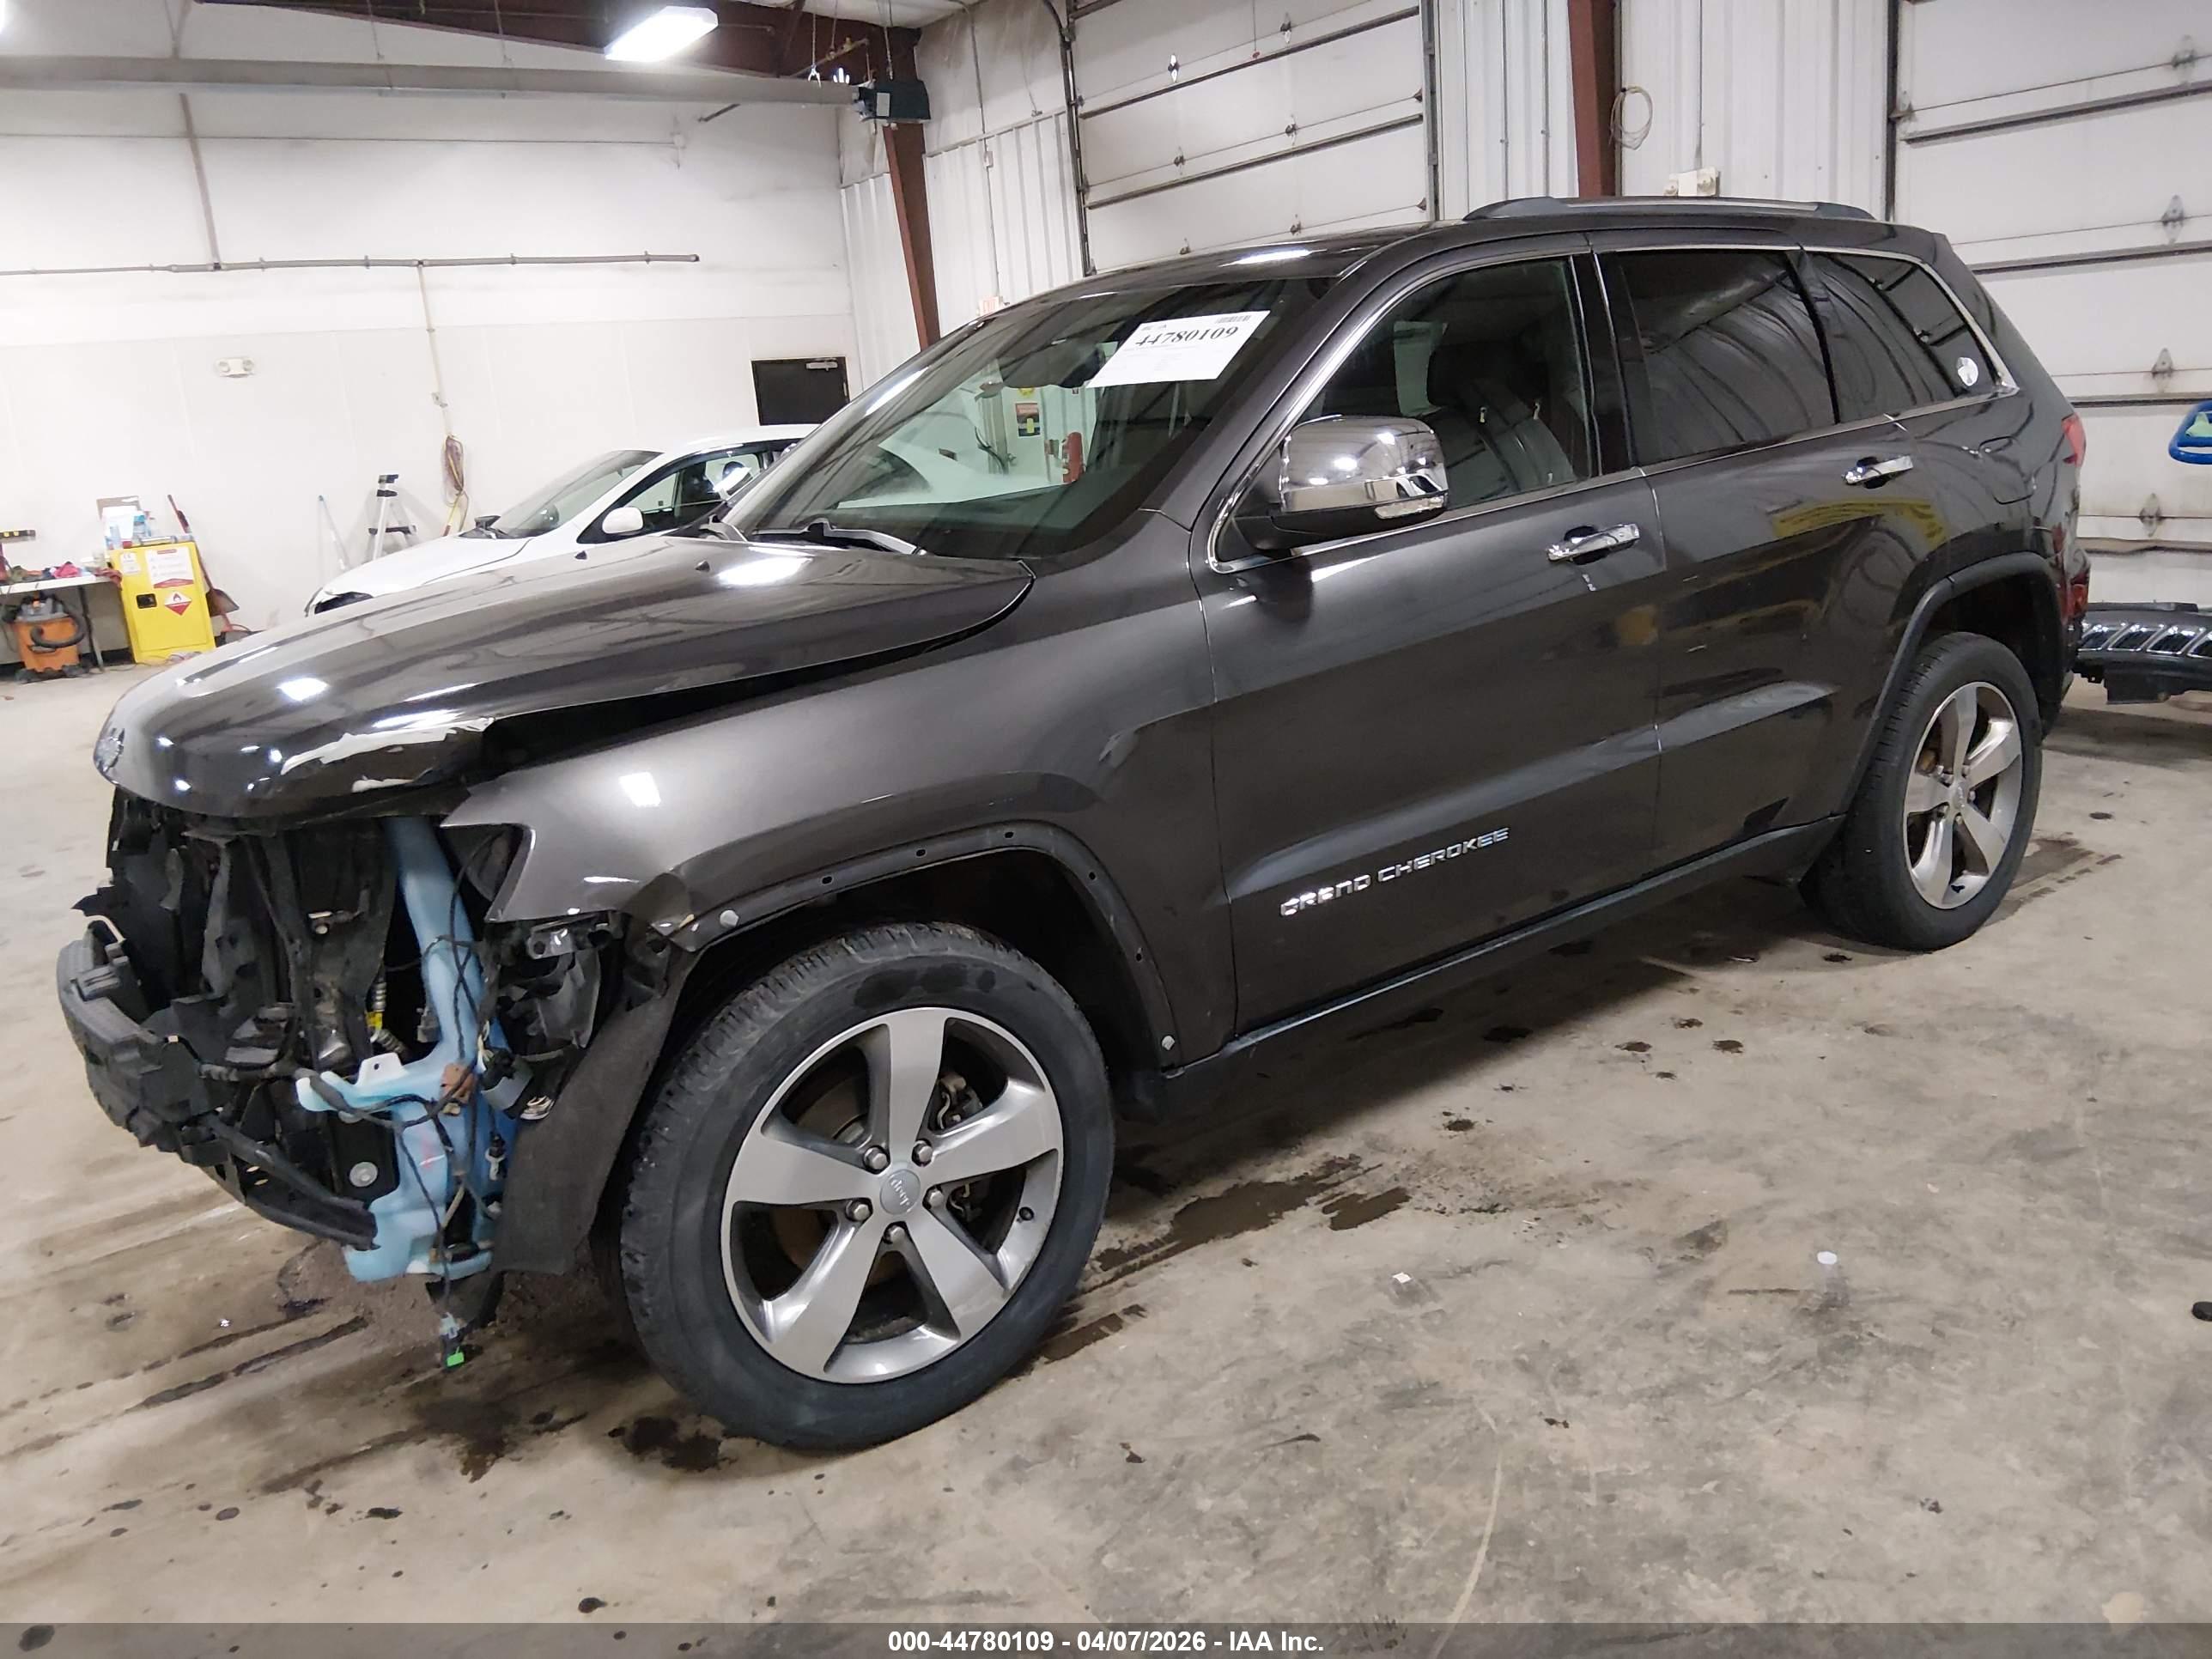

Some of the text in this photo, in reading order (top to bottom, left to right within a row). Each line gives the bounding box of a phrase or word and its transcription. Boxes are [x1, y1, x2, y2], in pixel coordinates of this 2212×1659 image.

[1135, 326, 1239, 347] 44780109
[1280, 827, 1510, 916] GRAND CHEROKEE
